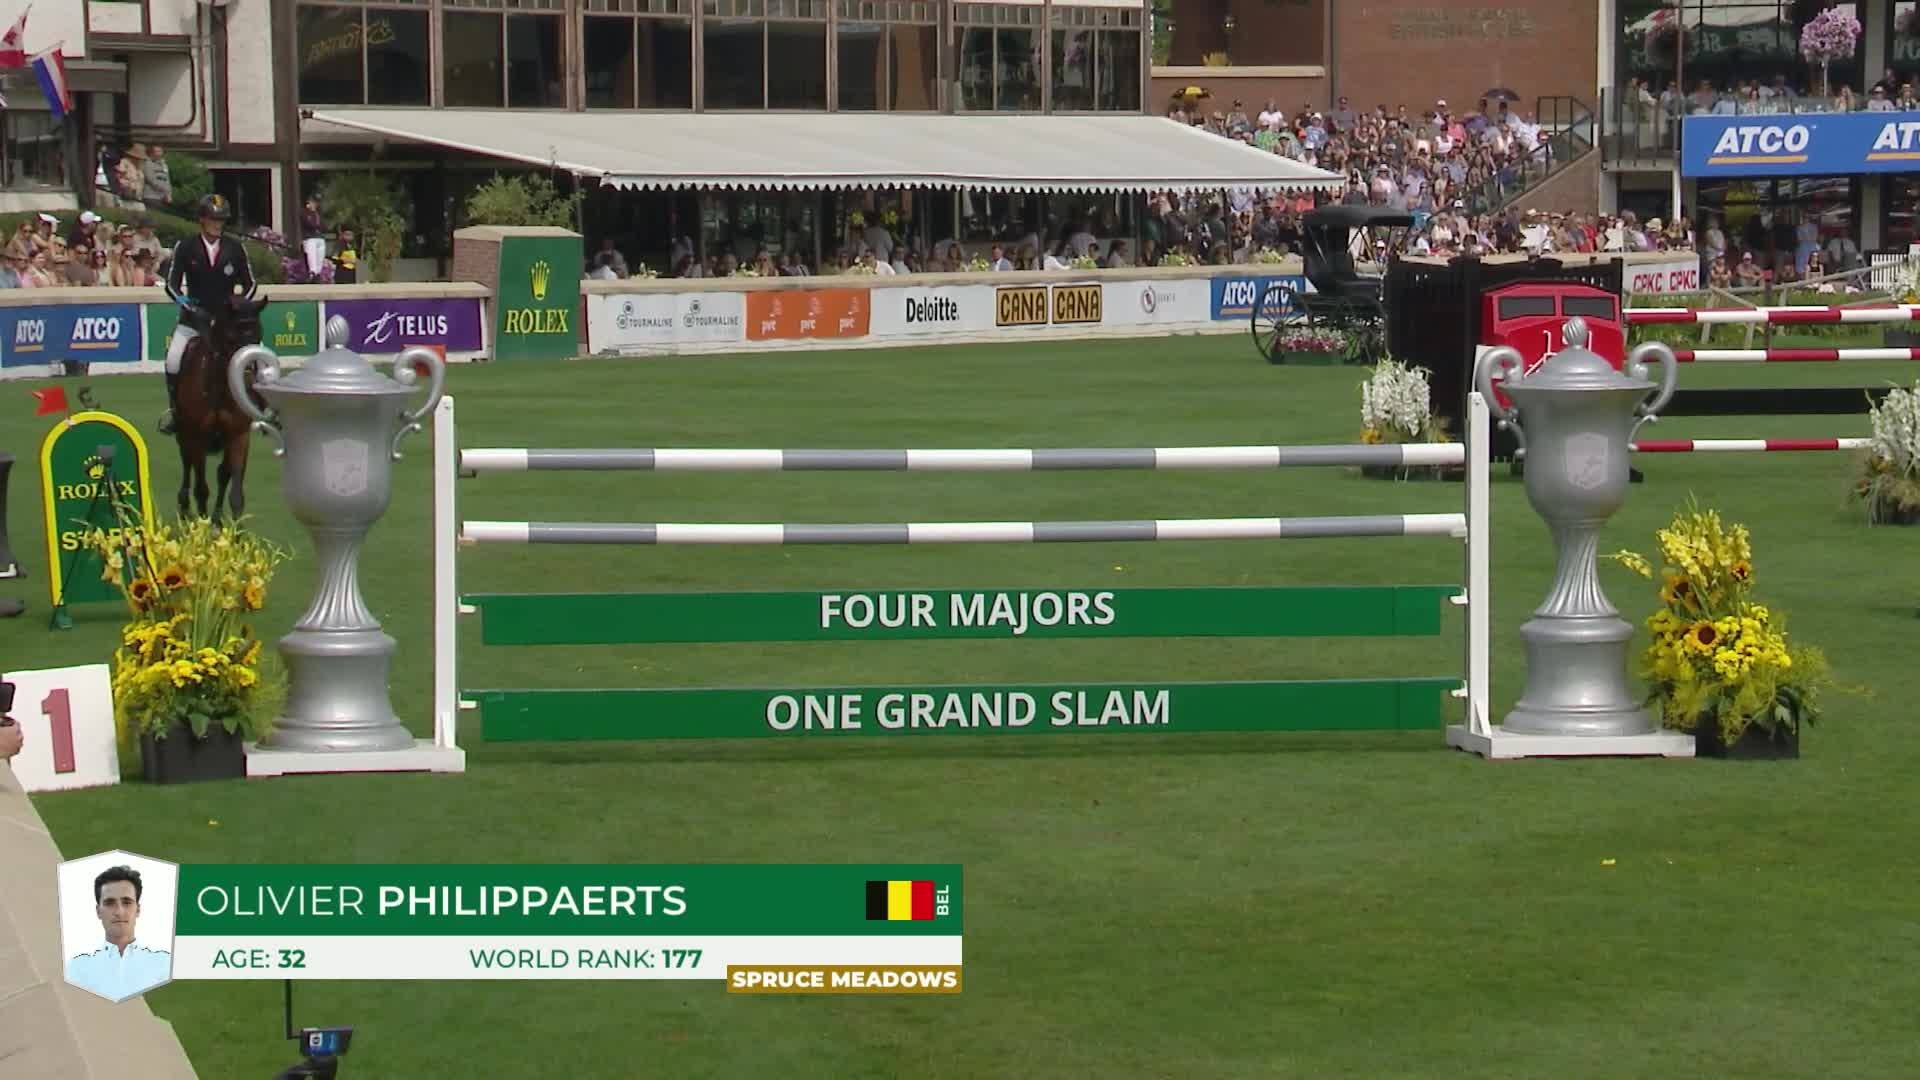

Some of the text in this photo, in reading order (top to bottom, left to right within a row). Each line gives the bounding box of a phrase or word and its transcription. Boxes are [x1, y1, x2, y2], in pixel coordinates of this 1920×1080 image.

[1713, 124, 1809, 153] ATCO
[1872, 122, 1920, 150] AT
[1222, 280, 1256, 306] ATCO
[1669, 269, 1697, 291] CPKC
[1000, 292, 1045, 322] CANA
[1056, 289, 1100, 319] CANA
[15, 319, 46, 343] ATCO
[72, 317, 121, 340] ATCO
[397, 315, 448, 336] TELUS
[504, 308, 569, 334] ROLEX
[629, 317, 673, 328] TOURMALINE
[695, 315, 739, 327] TOURMALINE
[274, 333, 306, 346] ROLEX
[820, 591, 1117, 635] FOUR MAJORS
[766, 689, 1171, 731] ONE GRAND SLAM
[41, 688, 76, 775] 1
